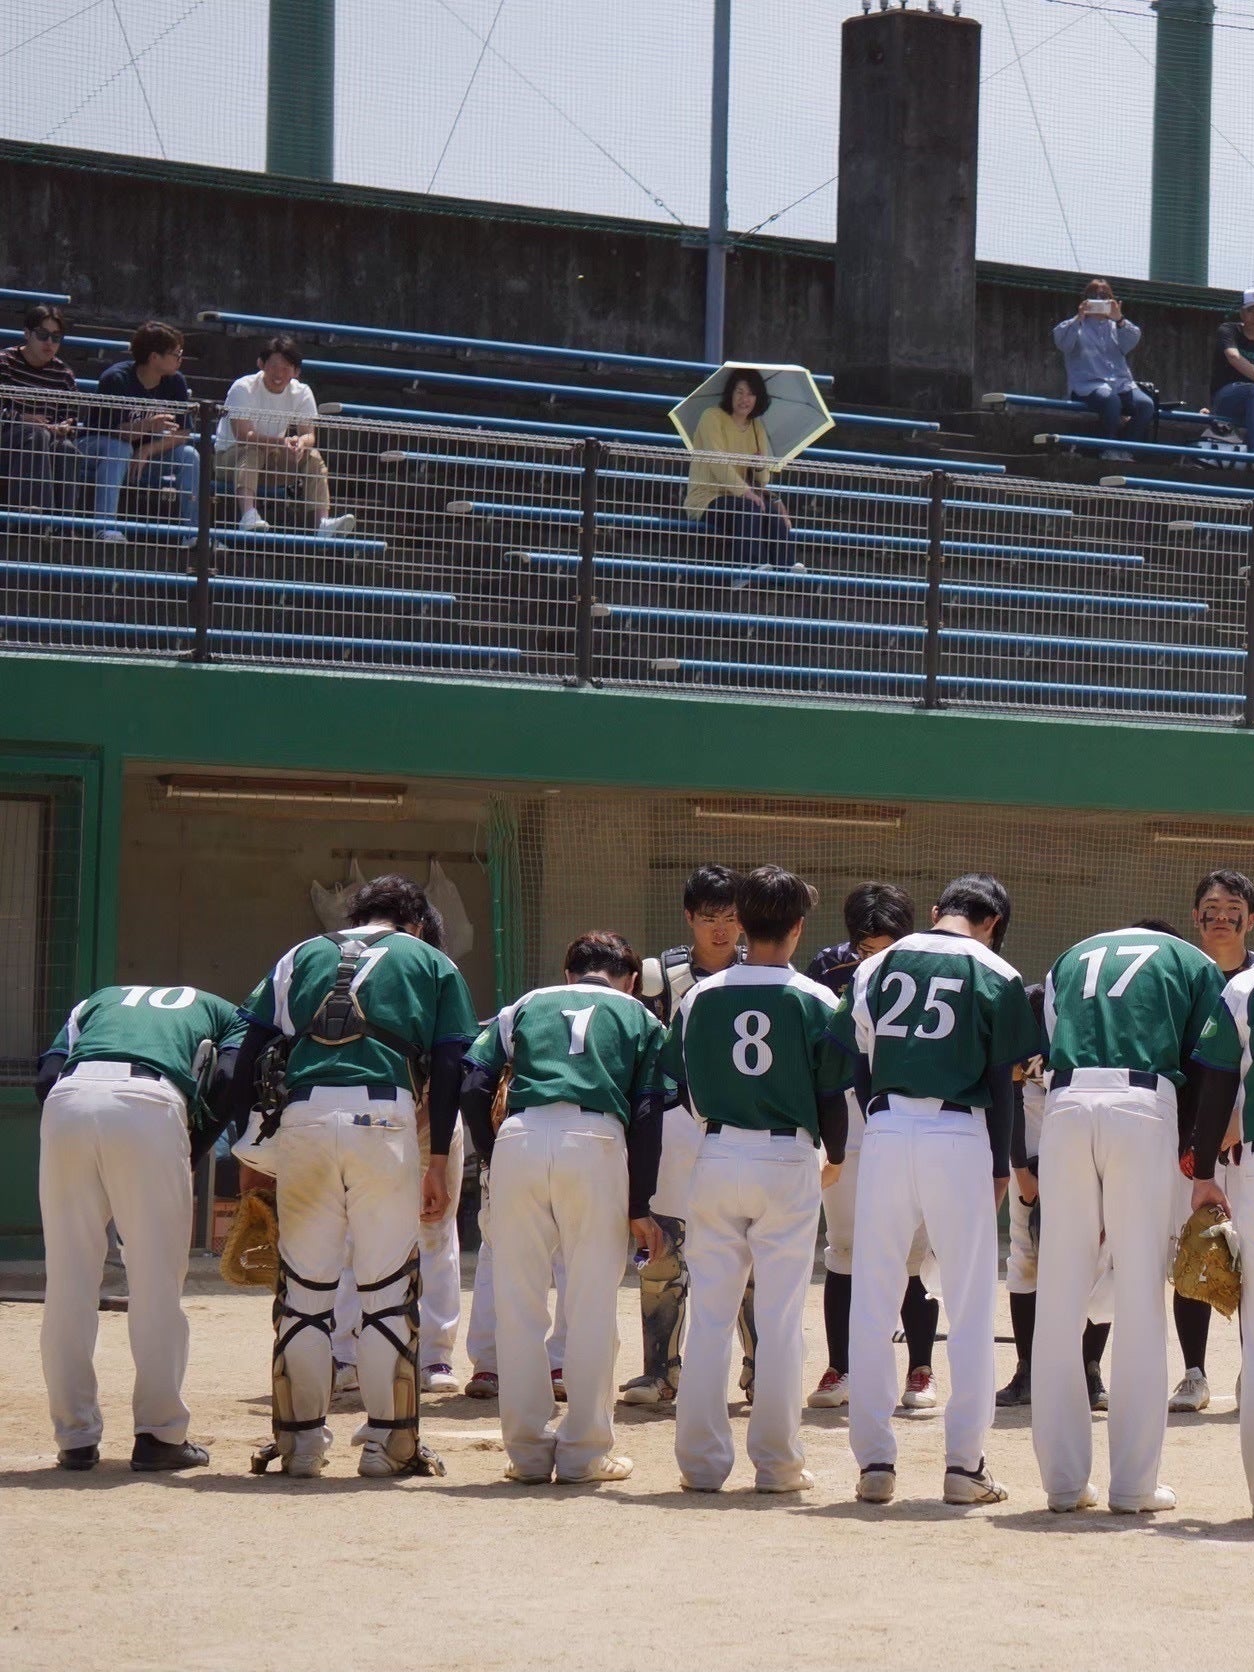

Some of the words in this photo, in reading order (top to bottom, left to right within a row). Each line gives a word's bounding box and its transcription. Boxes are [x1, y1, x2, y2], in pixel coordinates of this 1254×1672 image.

[349, 946, 389, 995] 7
[1079, 944, 1160, 999] 17
[119, 985, 197, 1010] 10
[875, 971, 965, 1040] 25
[560, 1004, 597, 1055] 1
[732, 1010, 772, 1076] 8
